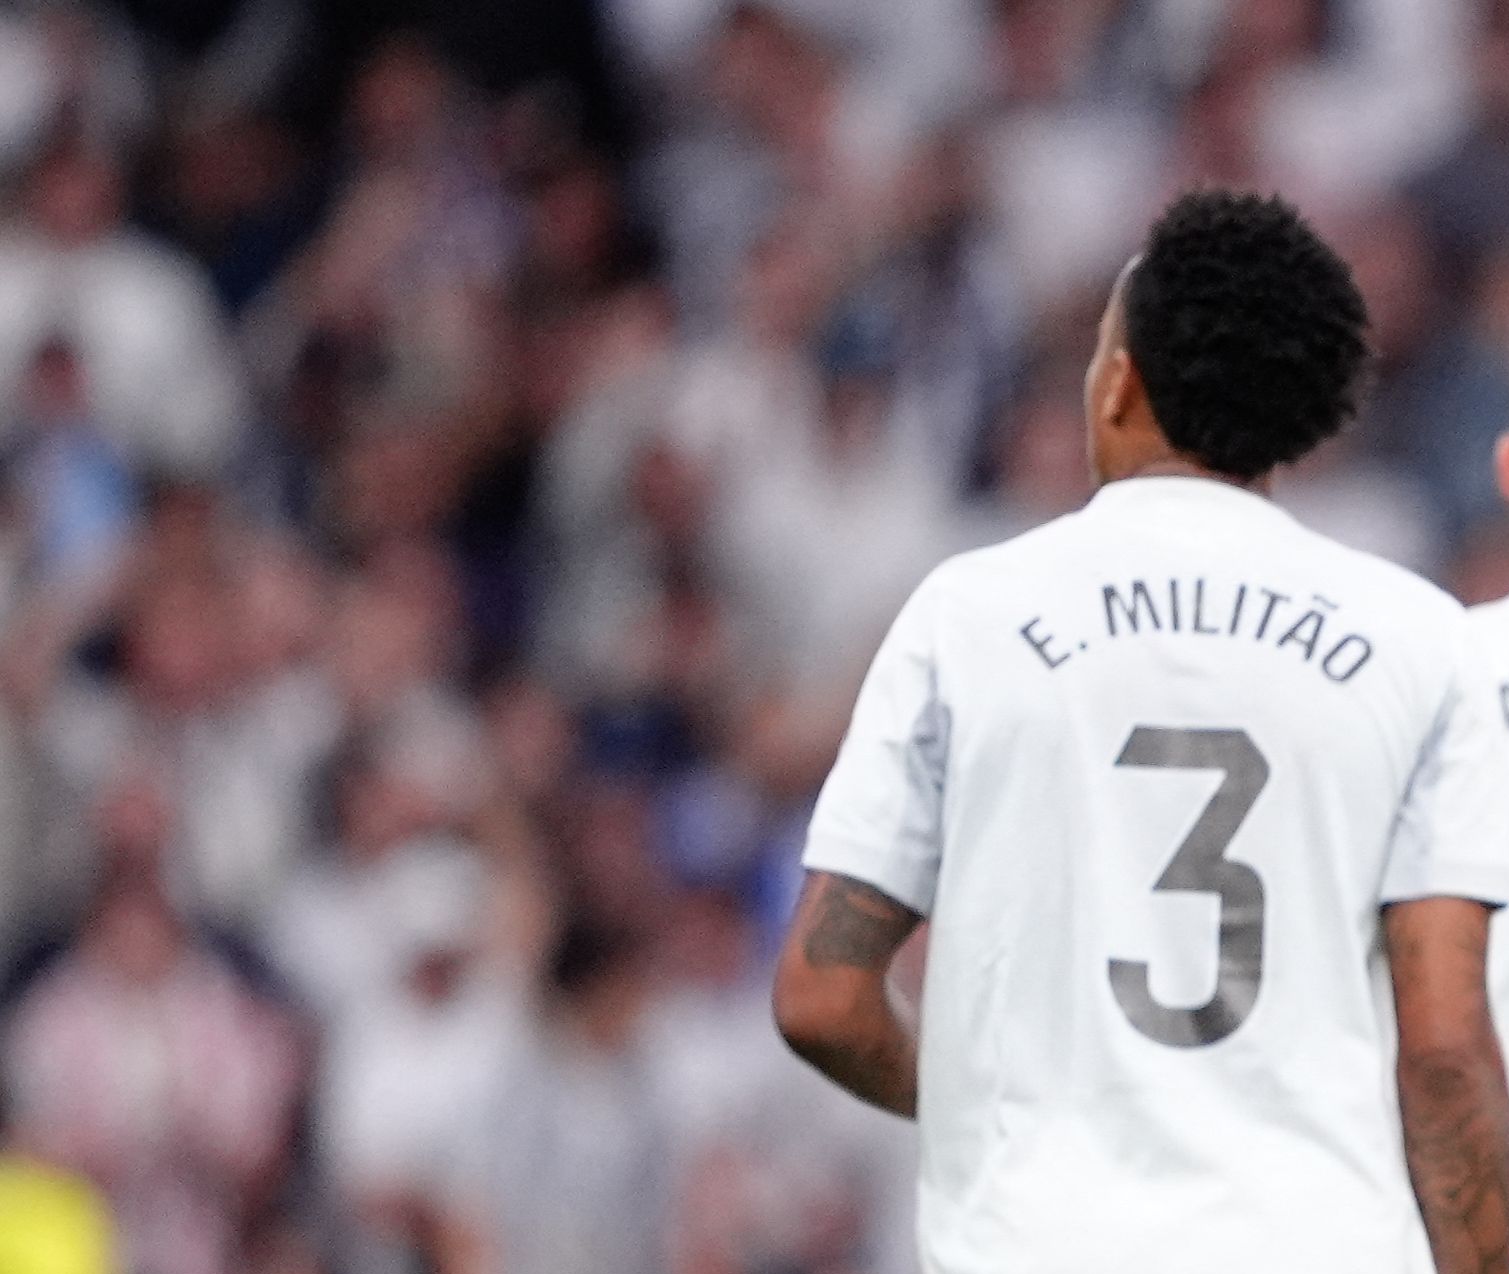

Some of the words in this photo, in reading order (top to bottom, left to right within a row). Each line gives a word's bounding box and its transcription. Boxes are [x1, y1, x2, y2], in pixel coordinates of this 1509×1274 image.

[1019, 616, 1088, 669] E.
[1101, 577, 1374, 684] MILITÃO
[1107, 725, 1270, 1048] 3
